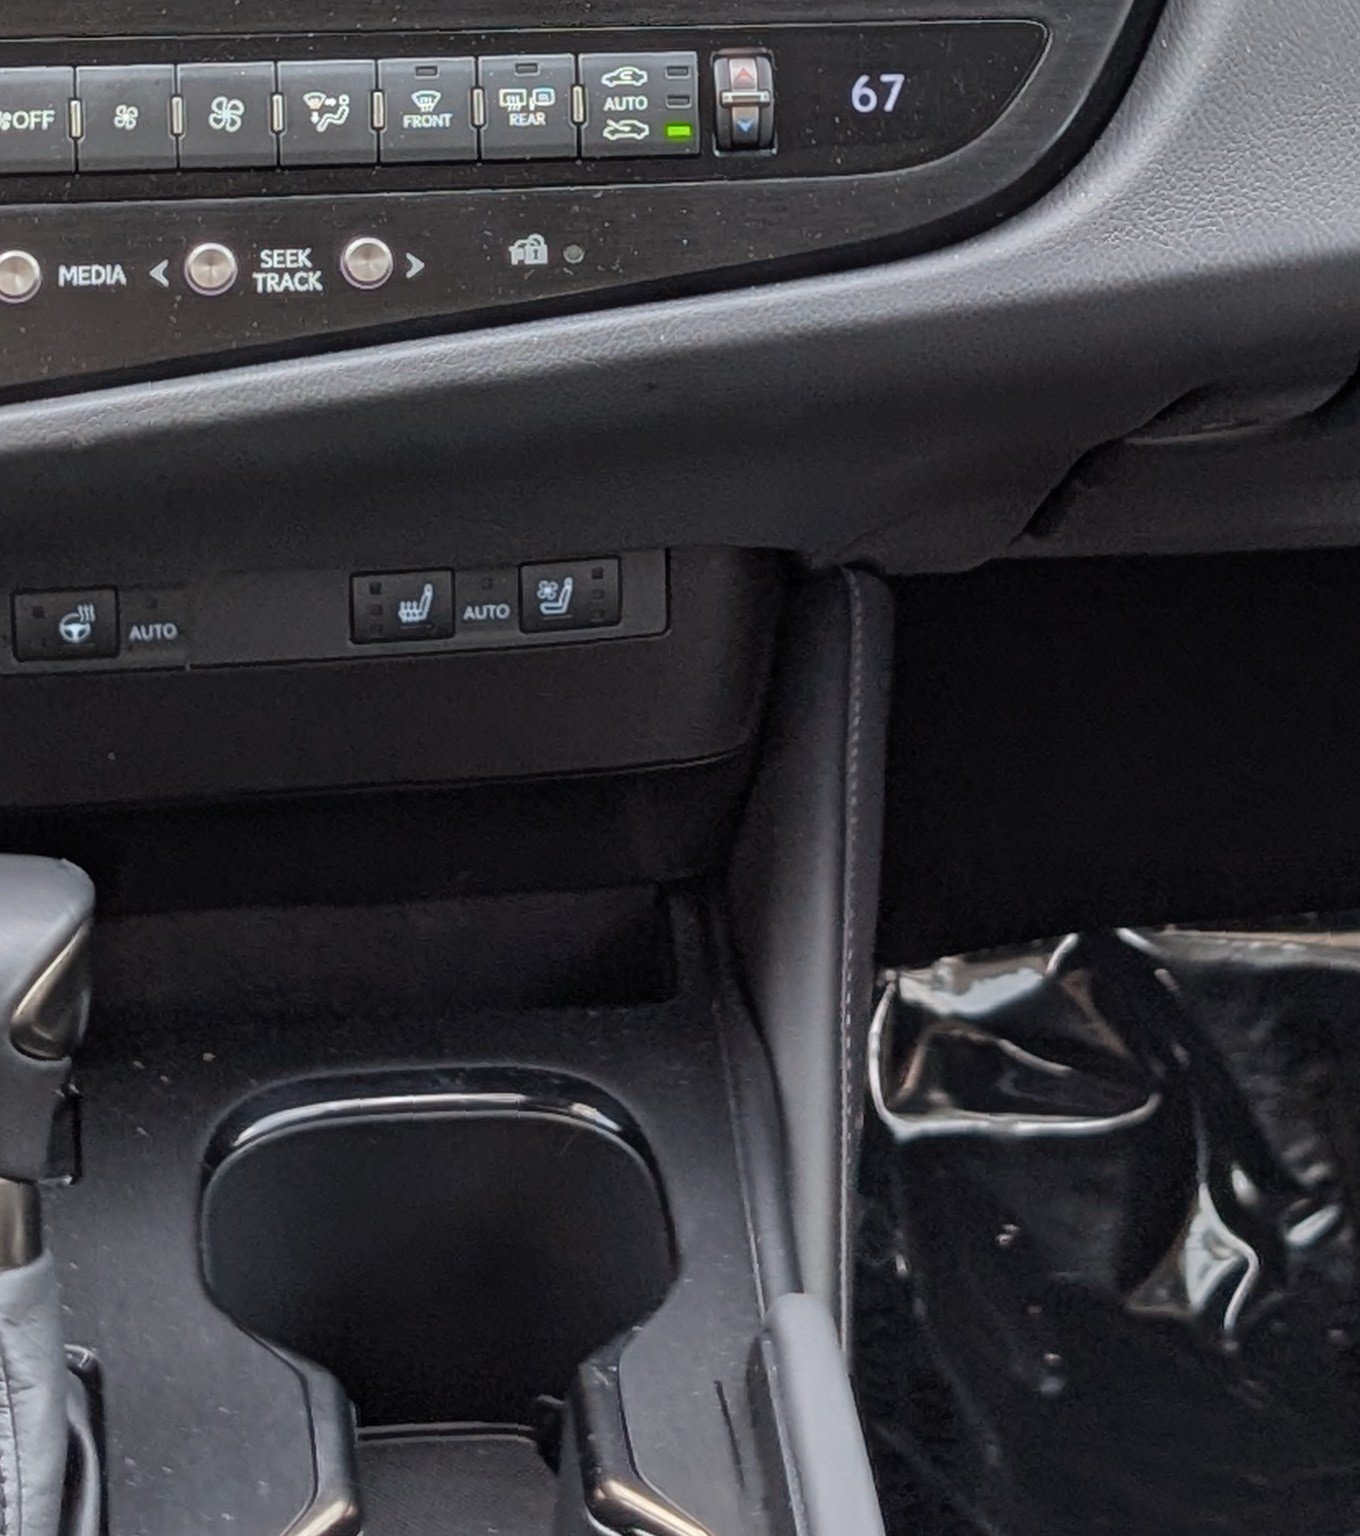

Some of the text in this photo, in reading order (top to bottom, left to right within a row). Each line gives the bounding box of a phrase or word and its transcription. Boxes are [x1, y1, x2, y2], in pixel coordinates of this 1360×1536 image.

[851, 72, 906, 114] 67
[603, 96, 648, 112] AUTO
[13, 109, 55, 131] OFF
[402, 114, 452, 129] FRONT
[508, 113, 546, 127] REAR
[260, 248, 312, 269] SEEK
[58, 263, 126, 286] MEDIA
[253, 270, 322, 293] TRACK
[461, 601, 511, 621] AUTO
[129, 623, 178, 642] AUTO
